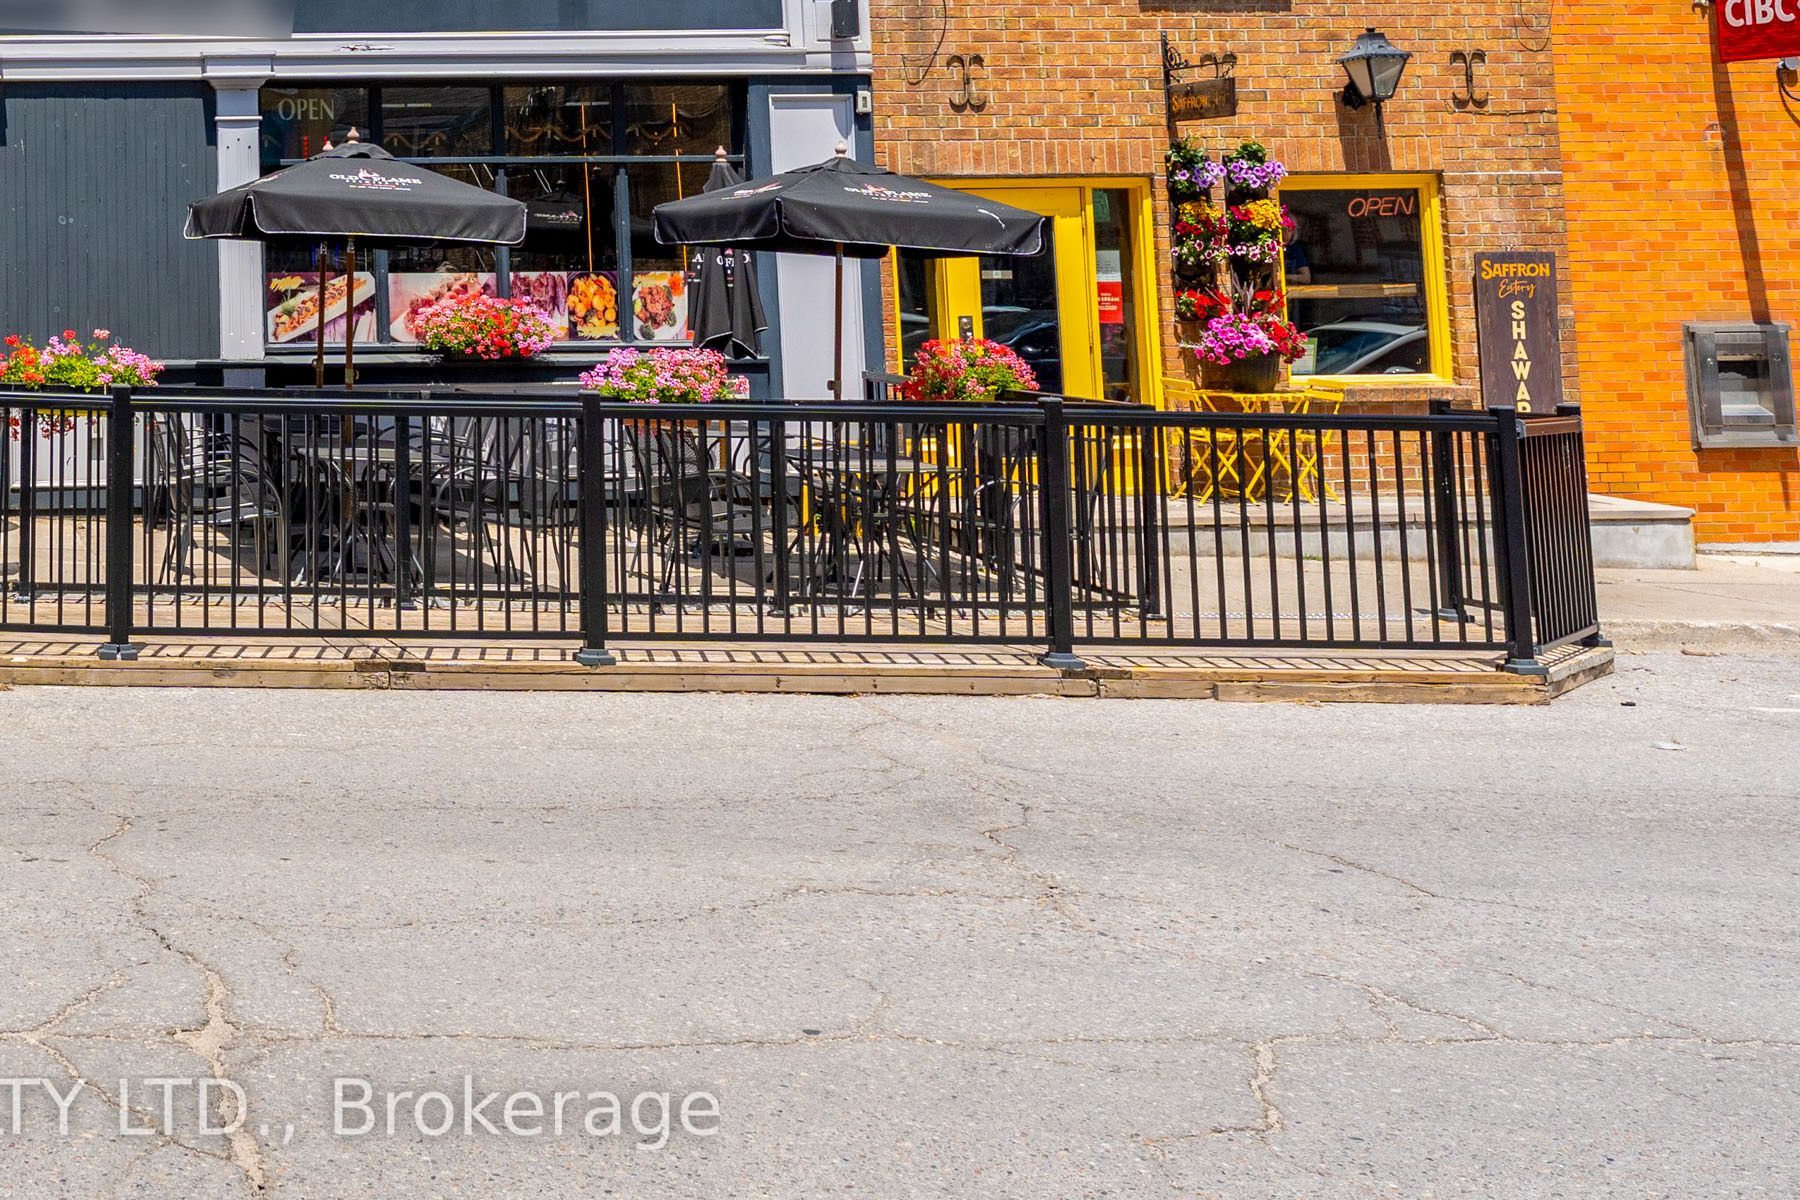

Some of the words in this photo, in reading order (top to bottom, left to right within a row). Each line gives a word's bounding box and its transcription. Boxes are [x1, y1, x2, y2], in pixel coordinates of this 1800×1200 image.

[279, 98, 334, 120] OPEN
[1348, 195, 1414, 216] OPEN
[1481, 259, 1550, 280] SAFFRON
[1498, 279, 1536, 298] Eatery
